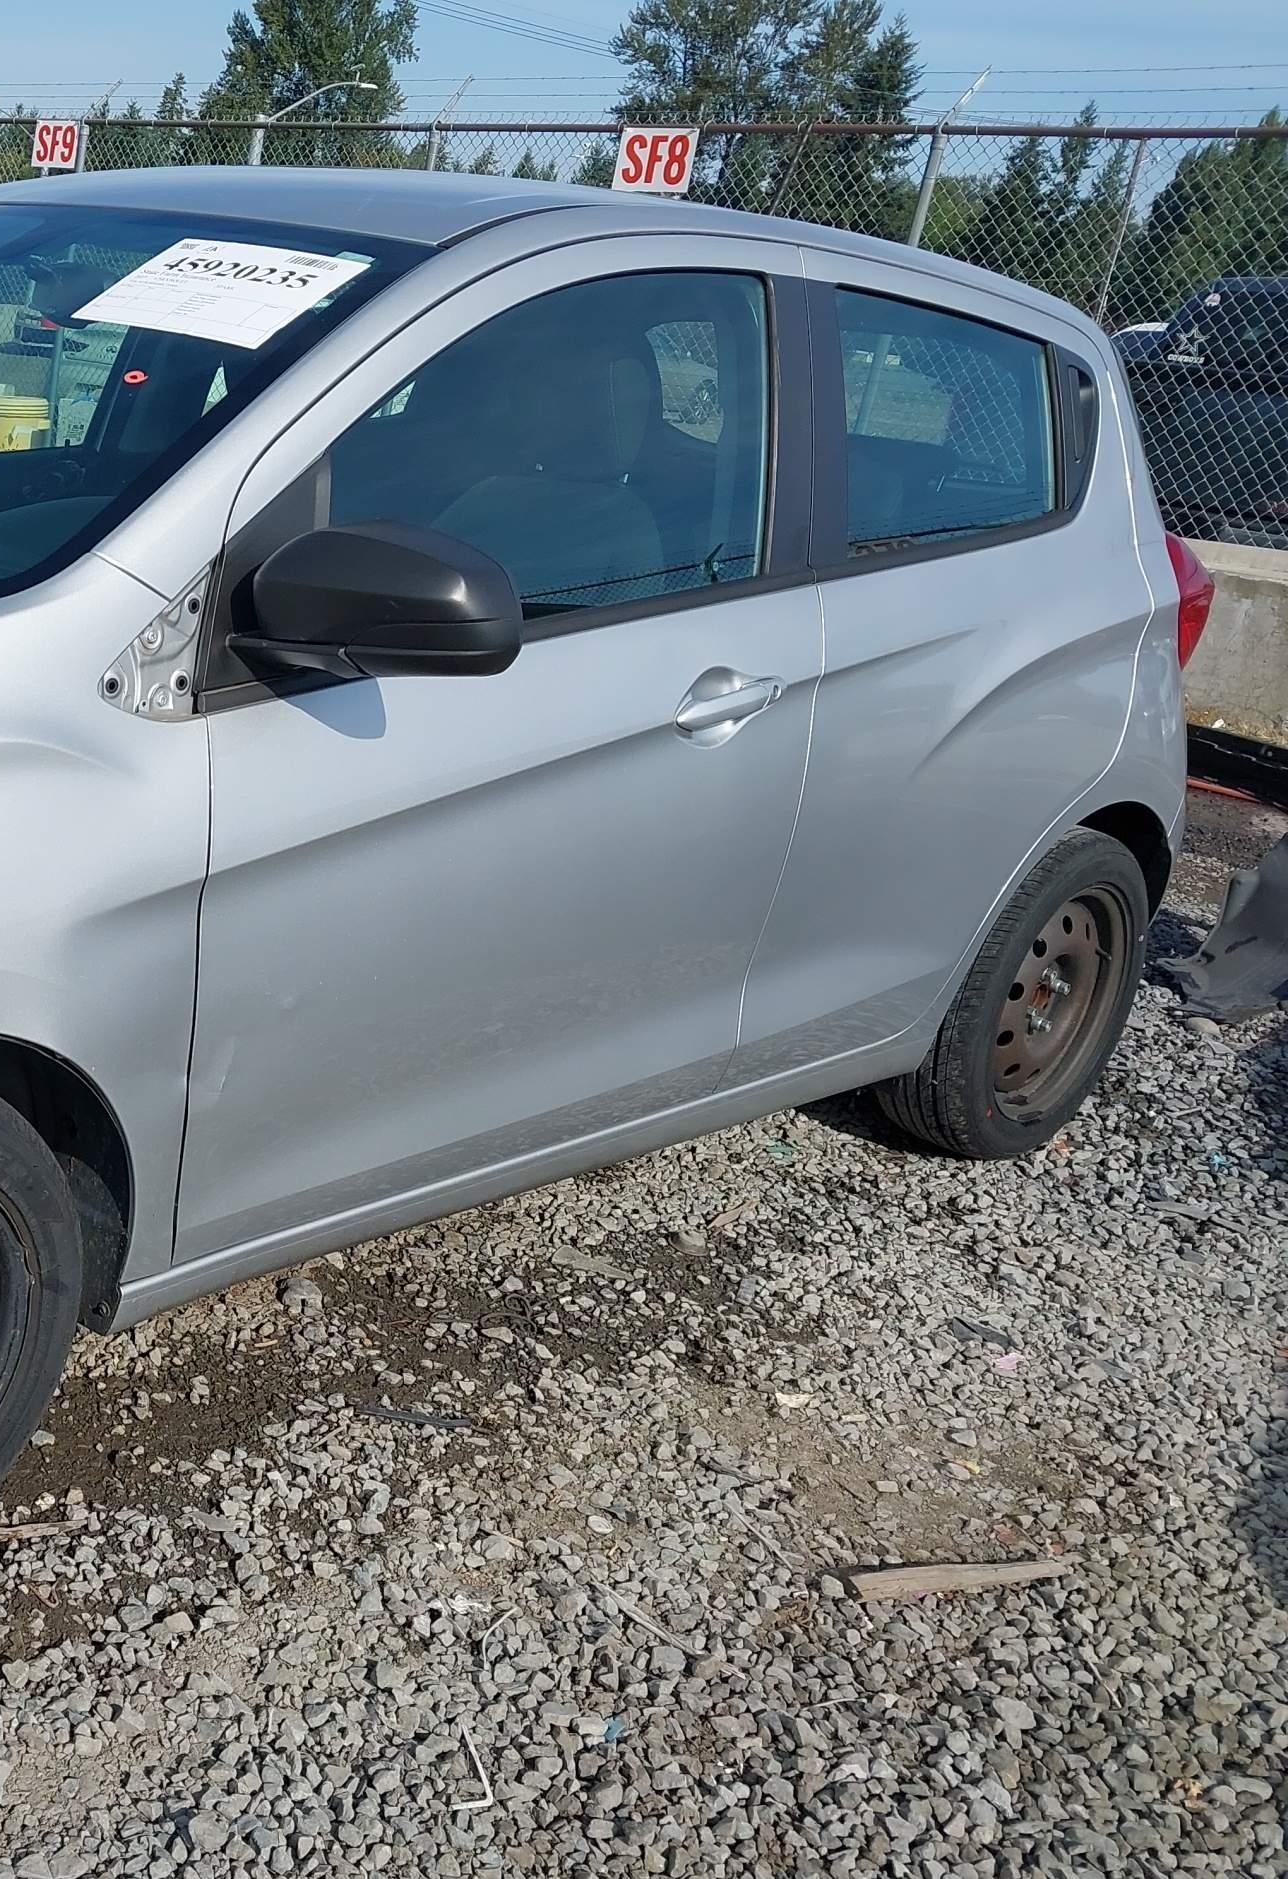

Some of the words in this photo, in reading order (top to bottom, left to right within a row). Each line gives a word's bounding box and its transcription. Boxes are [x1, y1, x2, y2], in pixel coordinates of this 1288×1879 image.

[35, 123, 76, 164] SF9
[621, 133, 690, 186] SF8
[164, 256, 319, 289] 45920235
